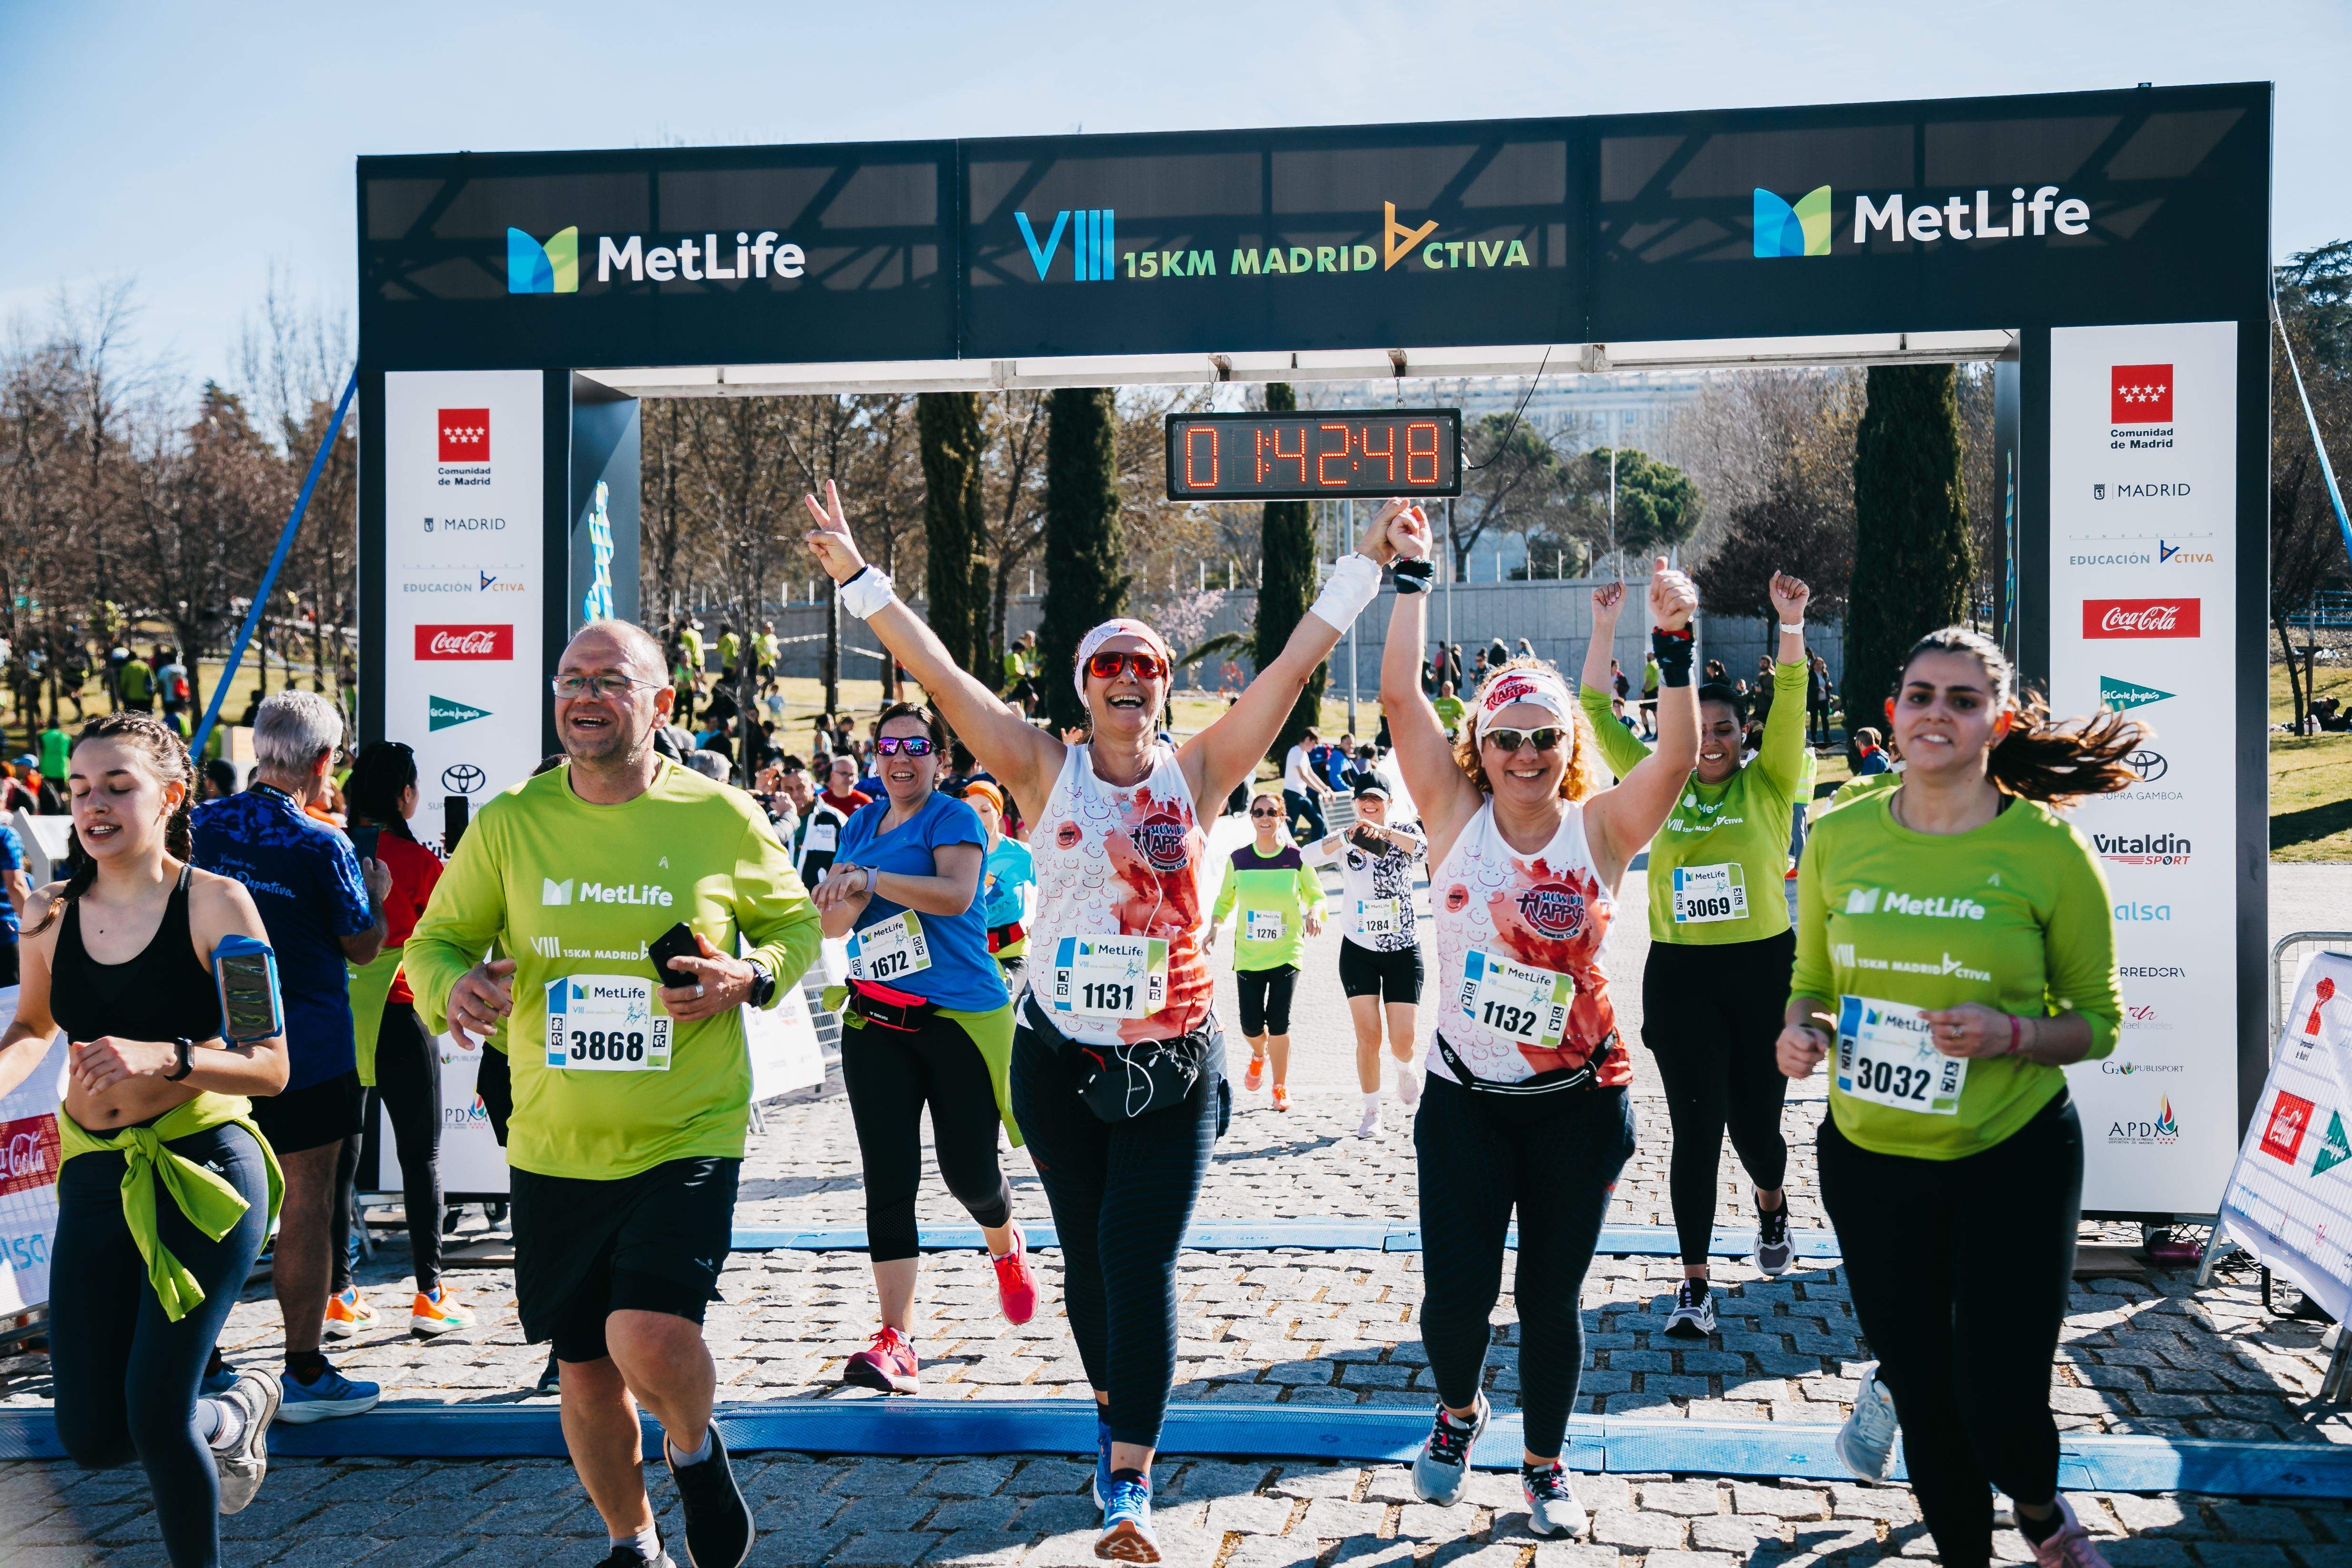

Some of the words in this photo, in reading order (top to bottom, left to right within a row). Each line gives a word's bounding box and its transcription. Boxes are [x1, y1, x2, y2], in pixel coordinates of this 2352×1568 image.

[1854, 186, 2090, 243] MetLife
[1014, 209, 1114, 282] VIII
[1124, 249, 1216, 278] 15KM
[1231, 245, 1377, 275] MADRID
[598, 231, 805, 282] MetLife
[2110, 428, 2174, 437] Comunidad
[2110, 441, 2125, 449] de
[2130, 439, 2174, 449] Madrid
[1186, 423, 1438, 488] 01:42:48
[438, 467, 491, 475] Comunidad
[455, 477, 491, 485] Madrid
[2118, 483, 2191, 497] MADRID
[445, 518, 505, 530] MADRID
[2070, 552, 2150, 565] EDUCACIÓN
[403, 581, 472, 592] EDUCACIÓN
[2101, 606, 2181, 631] Coca-Cola
[430, 631, 497, 654] Coca-Cola
[2100, 792, 2134, 800] SUPRA
[2136, 792, 2184, 800] GAMBOA
[2093, 833, 2191, 854] Vitaldin
[2145, 856, 2191, 865] SPORT
[1695, 871, 1726, 880] MetLife
[580, 882, 673, 907] MetLife
[1515, 893, 1585, 924] HAPPY
[1687, 897, 1730, 917] 3069
[1883, 891, 1986, 920] MetLife
[2114, 901, 2170, 921] alsa
[874, 922, 903, 938] MetLife
[1366, 920, 1389, 931] 1284
[1257, 929, 1277, 939] 1276
[530, 937, 561, 958] VIII
[563, 948, 591, 959] 15KM
[595, 949, 639, 961] MADRID
[1098, 944, 1143, 957] MetLife
[870, 950, 909, 979] 1672
[1508, 967, 1551, 986] MetLife
[594, 987, 646, 999] MetLife
[1083, 983, 1134, 1010] 1131
[573, 1006, 584, 1014] VIII
[1483, 1001, 1537, 1036] 1132
[571, 1030, 643, 1062] 3868
[2135, 1064, 2184, 1073] PUBLISPORT
[1858, 1057, 1931, 1101] 3032
[445, 1108, 488, 1123] PDM
[2108, 1122, 2179, 1137] APDM
